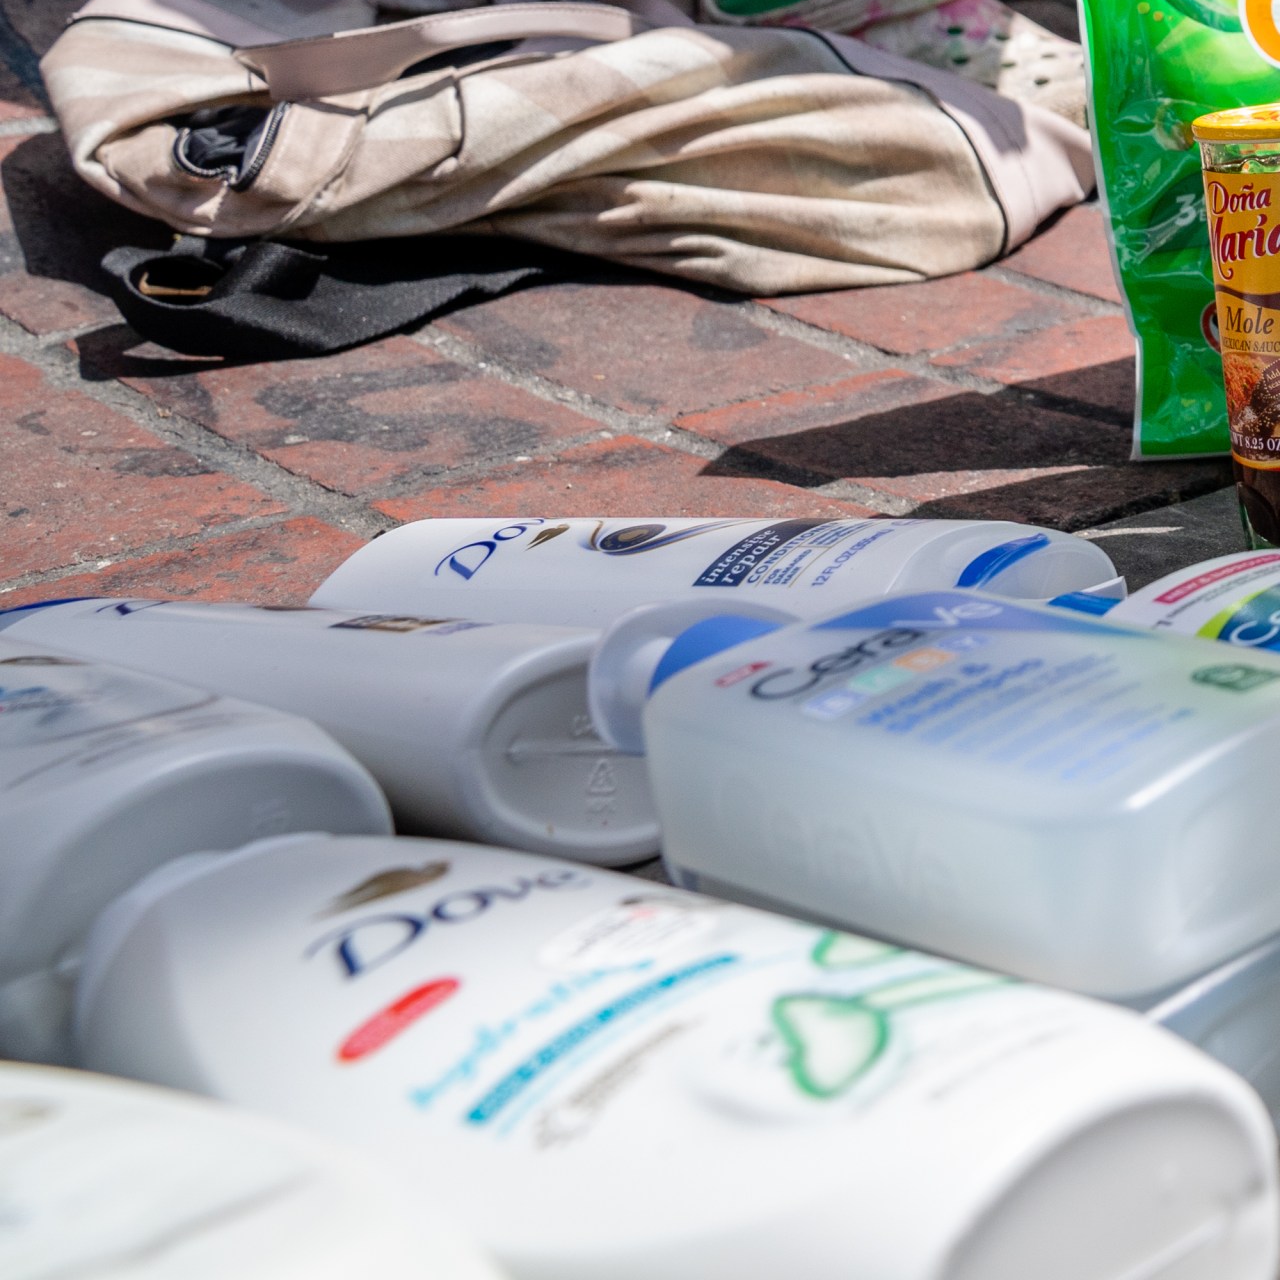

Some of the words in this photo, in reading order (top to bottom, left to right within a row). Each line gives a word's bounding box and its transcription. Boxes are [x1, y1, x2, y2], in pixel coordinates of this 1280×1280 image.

[1207, 181, 1271, 216] Doña
[1225, 305, 1275, 335] Mole
[1265, 368, 1280, 382] Add
[1244, 434, 1265, 451] 8.25
[701, 528, 776, 584] intensive
[722, 534, 782, 585] repair
